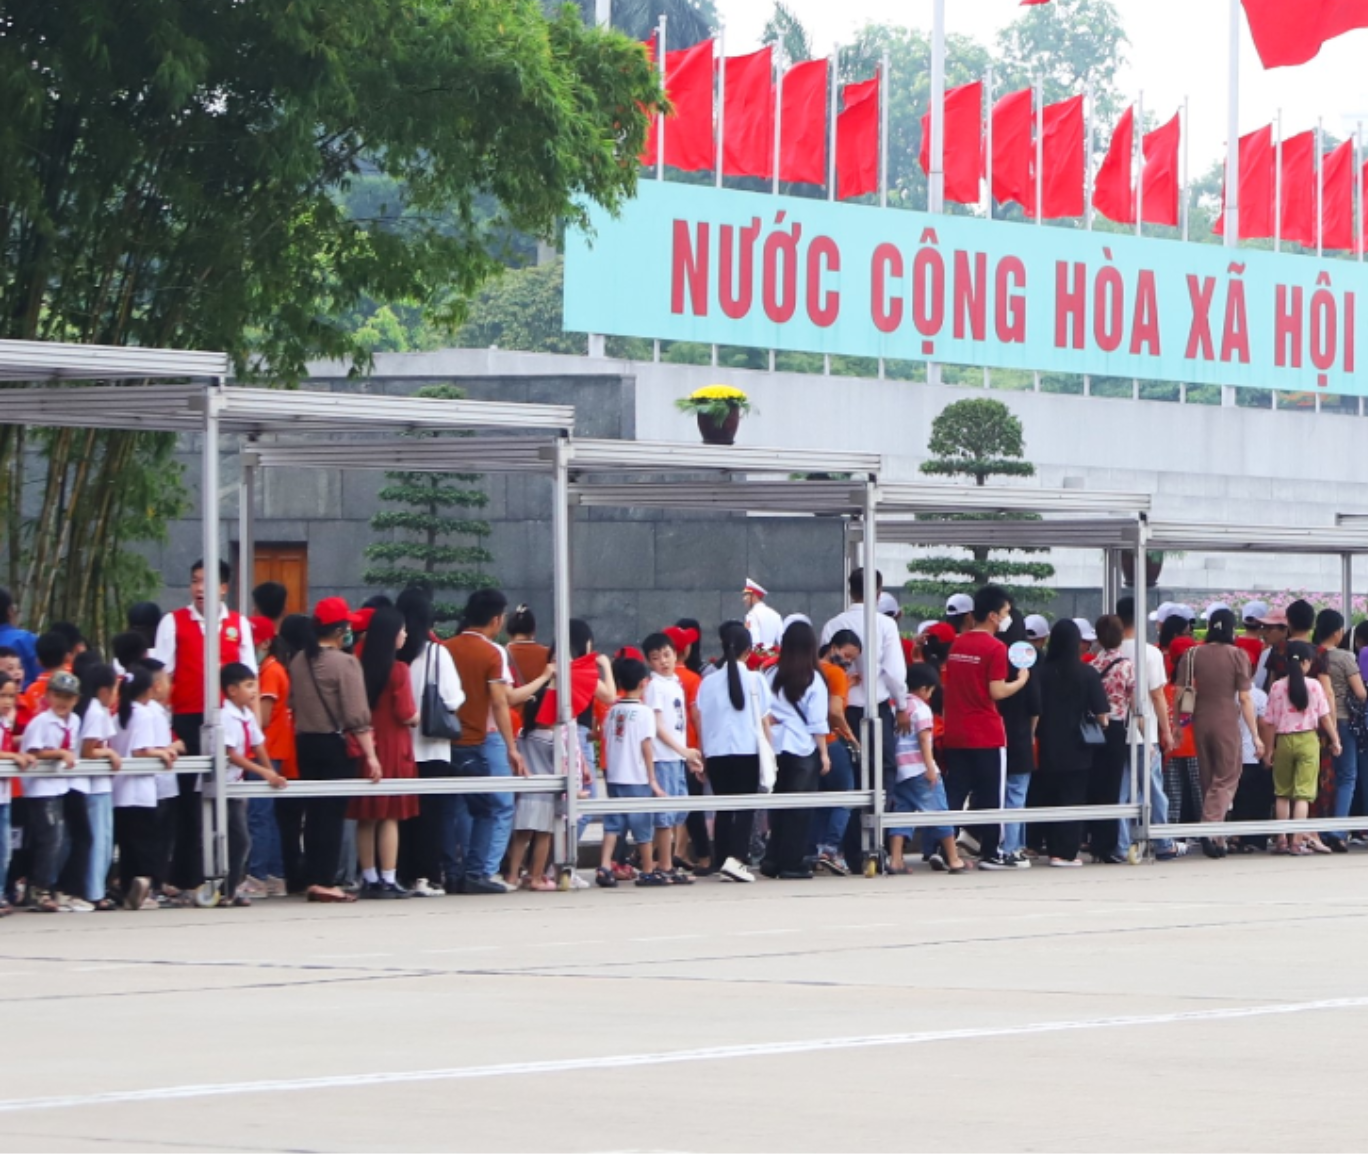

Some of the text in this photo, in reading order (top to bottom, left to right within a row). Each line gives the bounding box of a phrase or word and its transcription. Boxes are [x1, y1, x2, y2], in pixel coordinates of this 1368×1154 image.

[671, 209, 841, 328] NƯỚC
[870, 226, 1027, 355] CỘNG
[1054, 246, 1161, 357] HÒA
[1184, 260, 1251, 364] XÃ
[1274, 271, 1355, 387] HỘI
